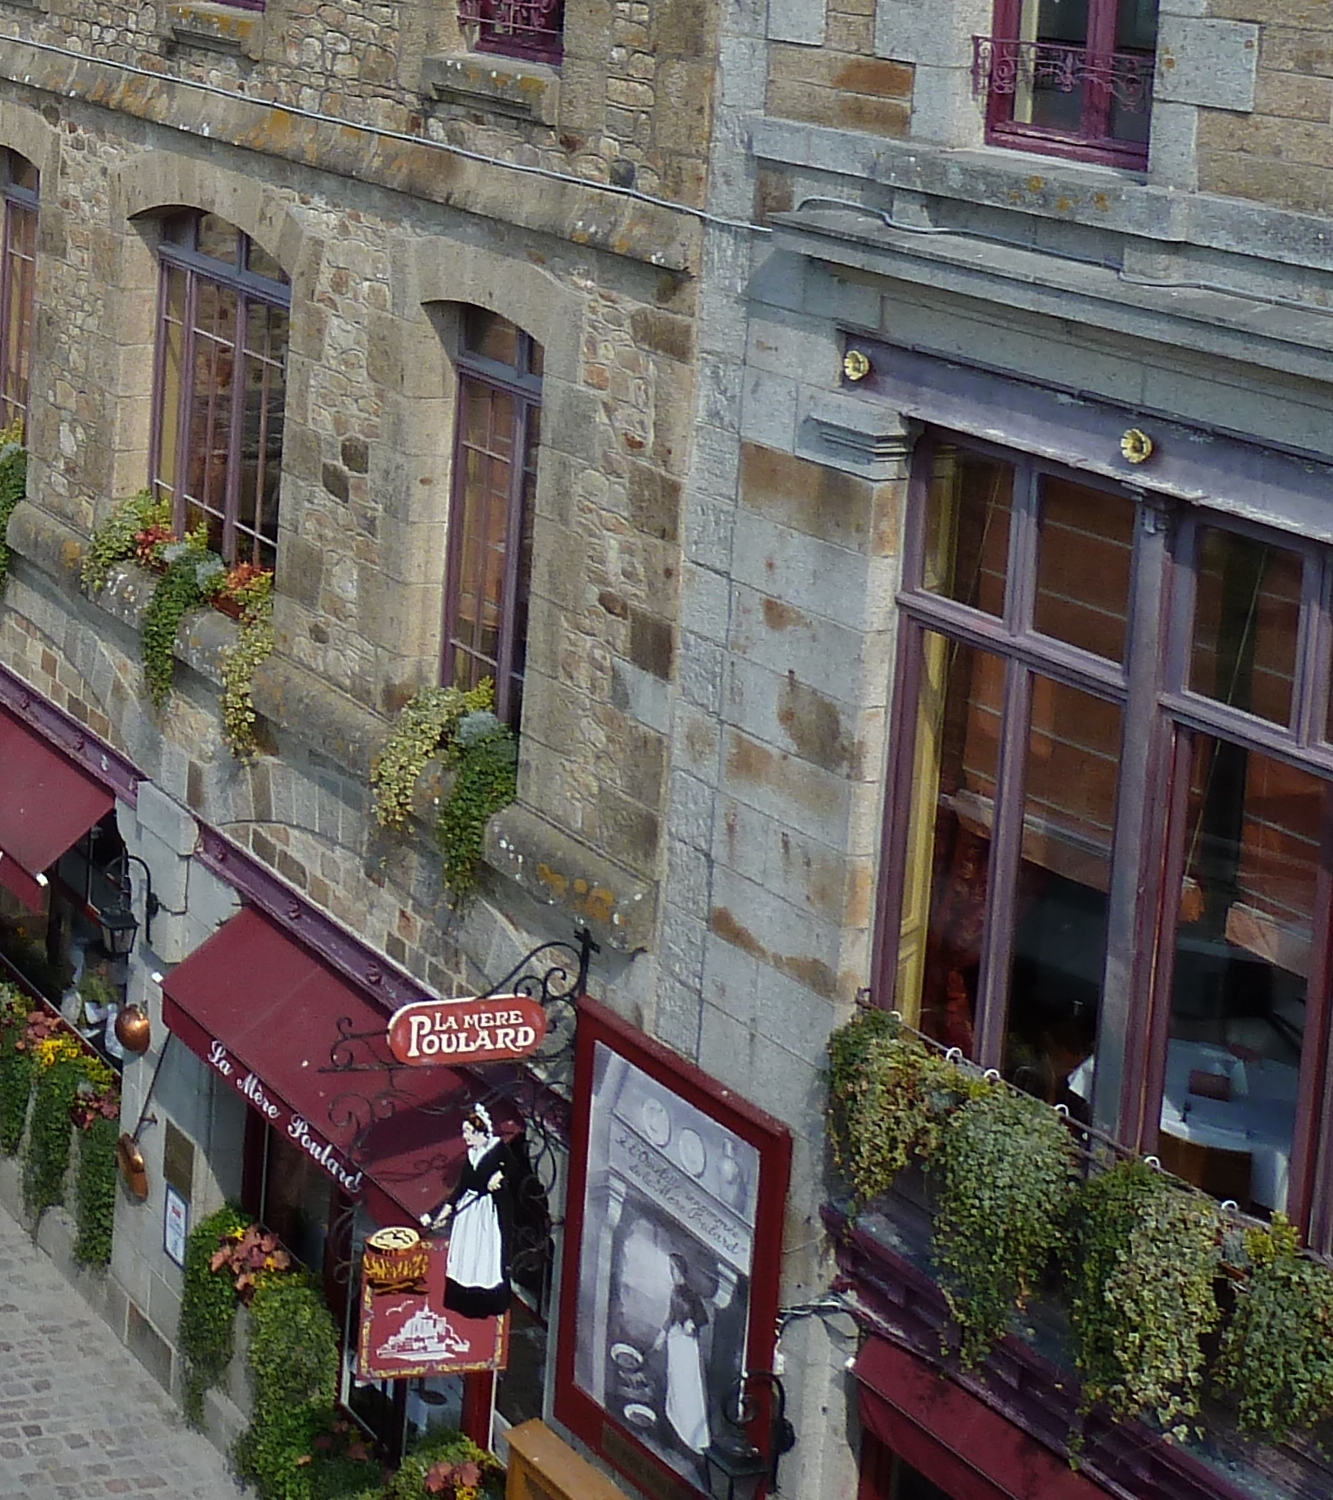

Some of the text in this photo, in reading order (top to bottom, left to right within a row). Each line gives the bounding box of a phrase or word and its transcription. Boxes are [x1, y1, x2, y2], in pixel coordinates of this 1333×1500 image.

[407, 1015, 536, 1058] POULARD
[434, 1010, 524, 1031] LA MERE
[207, 1039, 363, 1193] La Mère Poulard
